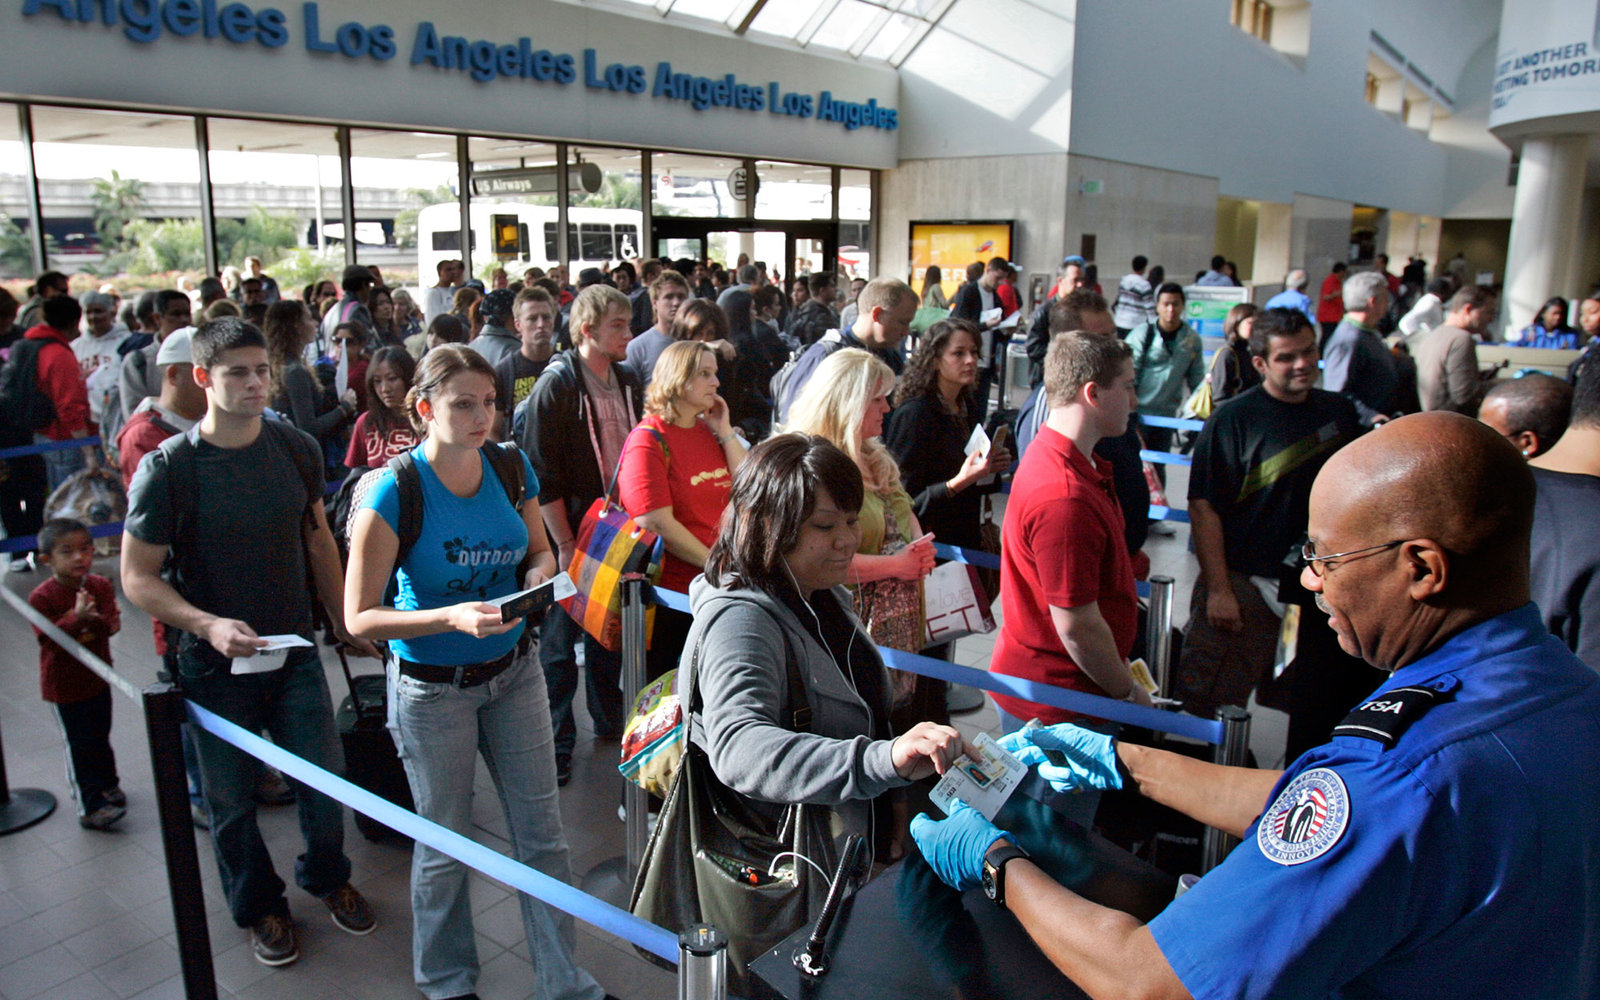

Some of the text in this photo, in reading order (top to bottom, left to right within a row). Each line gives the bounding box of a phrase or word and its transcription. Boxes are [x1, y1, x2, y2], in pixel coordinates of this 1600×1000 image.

[302, 1, 397, 60] Los
[411, 21, 577, 86] Angeles
[585, 47, 647, 94] Los
[652, 61, 766, 111] Angeles
[769, 81, 814, 119] Los
[817, 90, 899, 131] Angeles
[1513, 42, 1587, 70] ANOTHER
[1533, 58, 1600, 83] TOMOR
[493, 179, 532, 192] Airways
[365, 429, 417, 461] US
[1360, 700, 1403, 714] TSA
